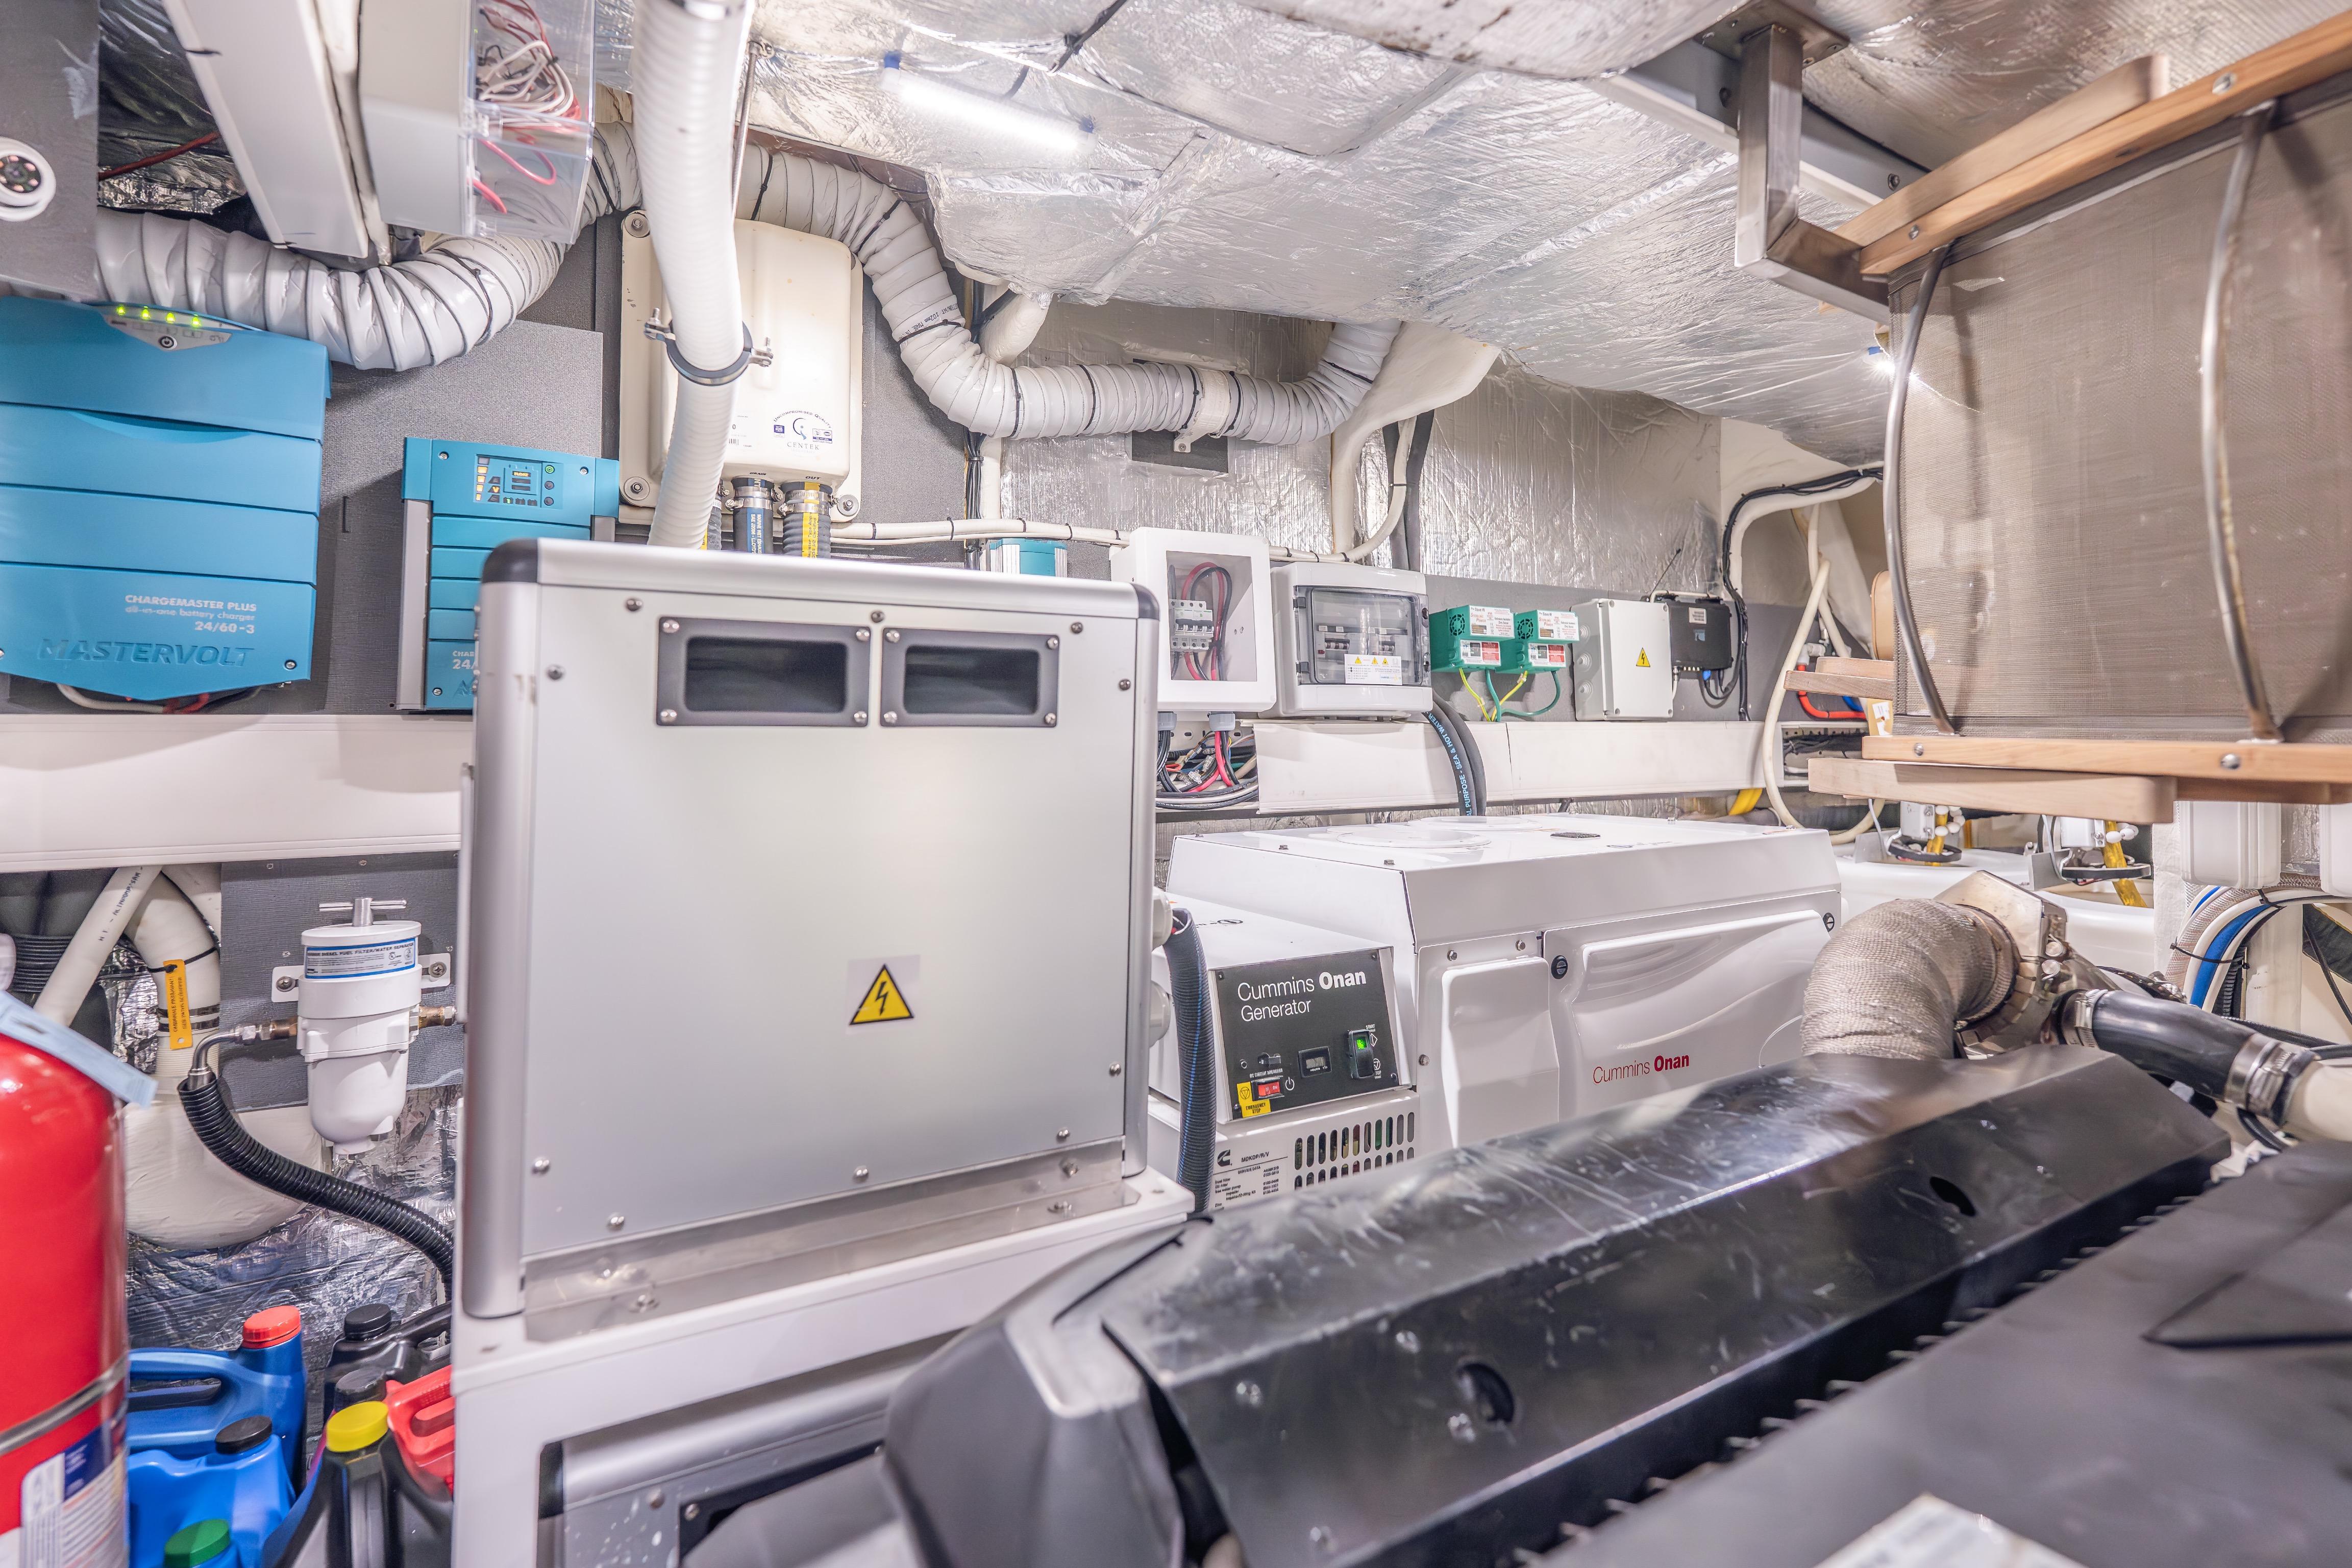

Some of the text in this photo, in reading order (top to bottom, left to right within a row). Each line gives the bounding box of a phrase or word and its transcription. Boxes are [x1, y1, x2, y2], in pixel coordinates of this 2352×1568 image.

[787, 442, 819, 450] CENTEK
[125, 595, 256, 611] CHARGEMASTER PLUS
[195, 621, 255, 634] 24/60-3
[38, 638, 255, 667] MASTERVOLT
[1428, 712, 1444, 734] WATER
[1443, 734, 1453, 748] HOT
[1453, 754, 1462, 769] SEA
[1459, 774, 1471, 808] PURPOSE
[1237, 971, 1367, 1001] Cummins Onan
[1241, 1000, 1311, 1022] Generator
[1593, 1054, 1689, 1084] Cummins Onan
